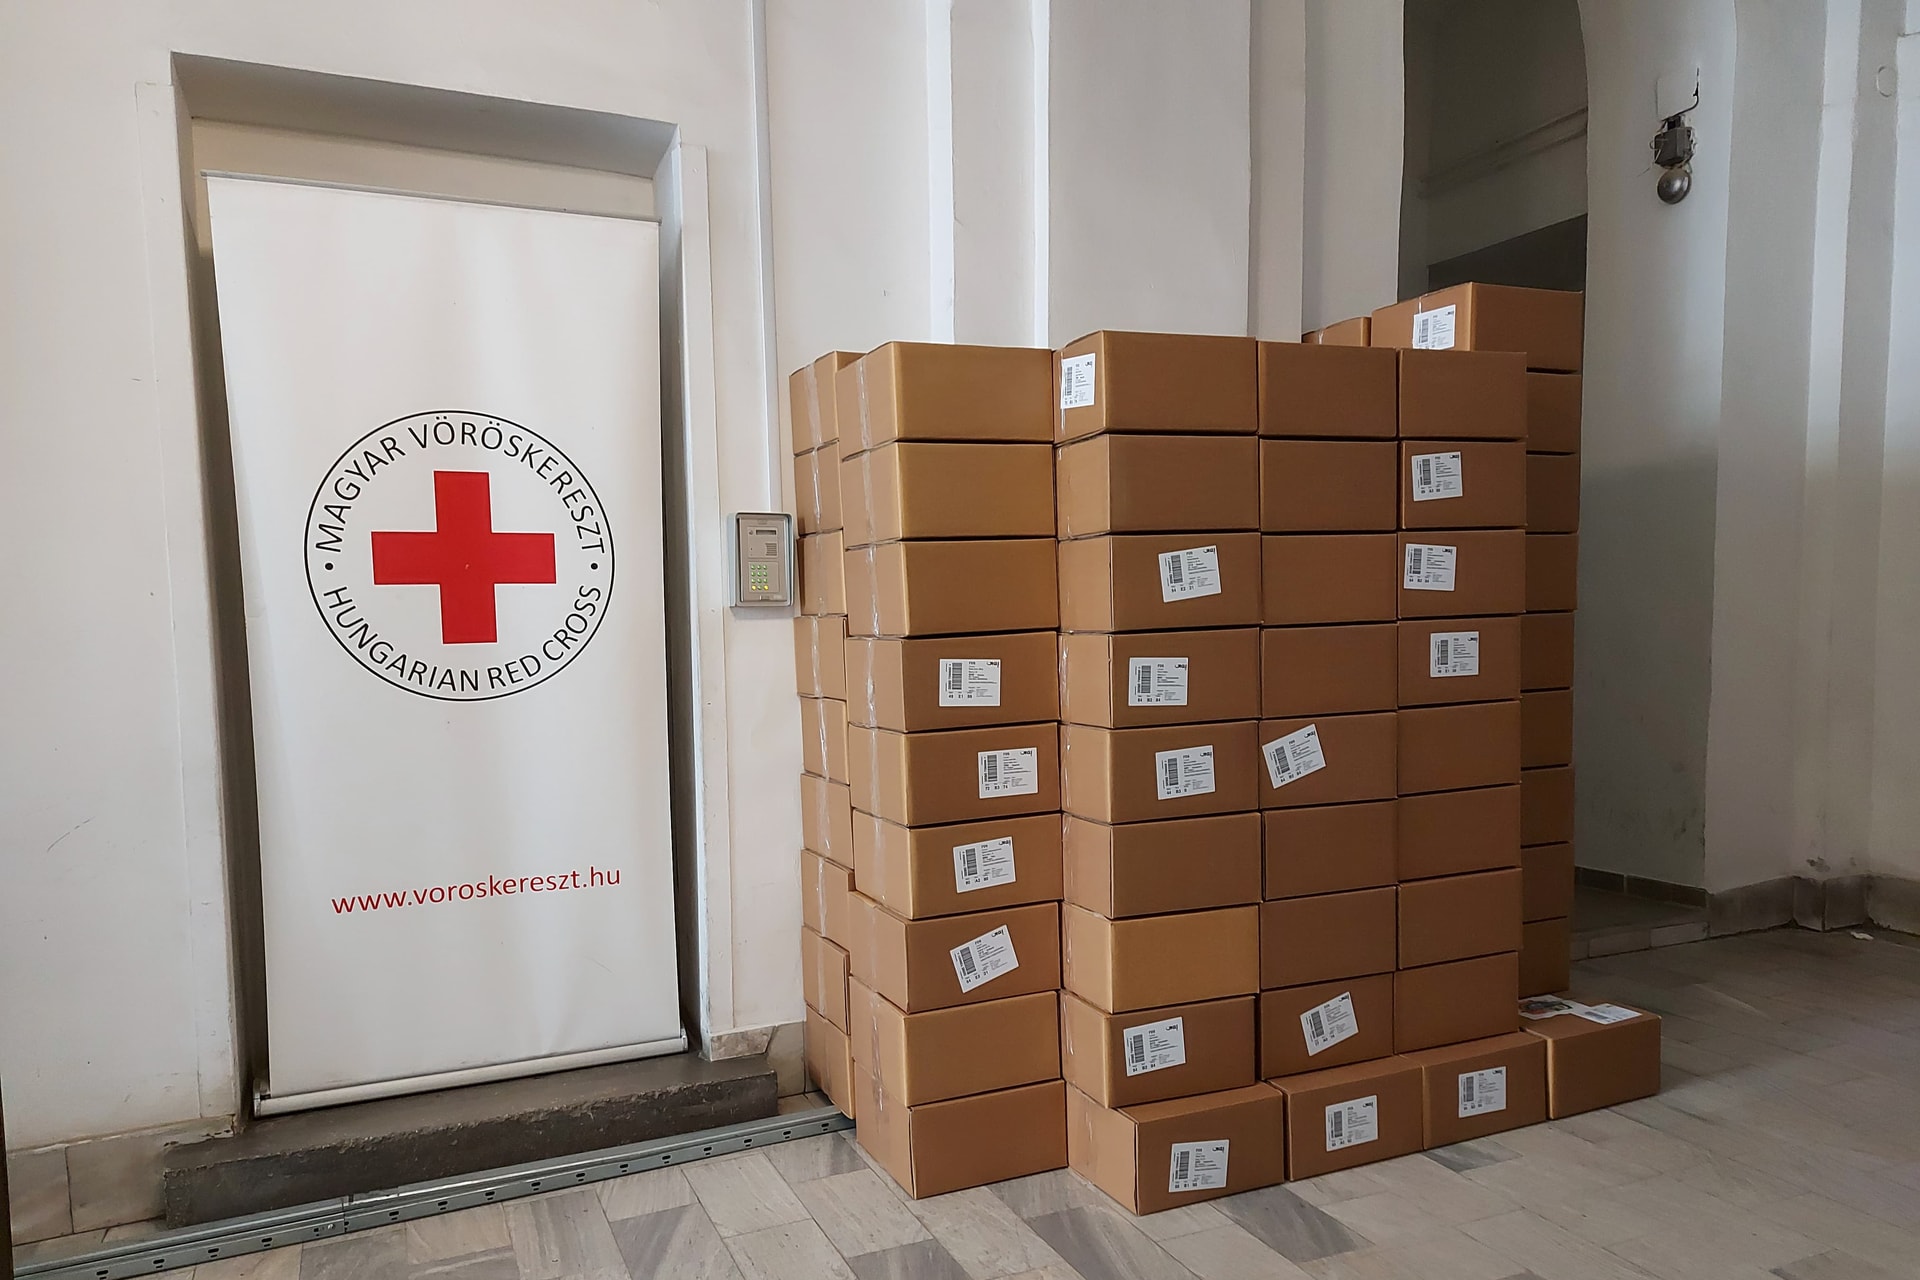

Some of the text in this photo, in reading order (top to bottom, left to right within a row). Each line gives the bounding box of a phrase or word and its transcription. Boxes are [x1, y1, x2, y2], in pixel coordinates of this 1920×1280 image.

[316, 415, 605, 553] MAGYAR VÖRÖSKERESZT
[323, 585, 601, 692] HUNGARIAN RED CROSS
[331, 866, 621, 914] www.voroskereszt.hu
